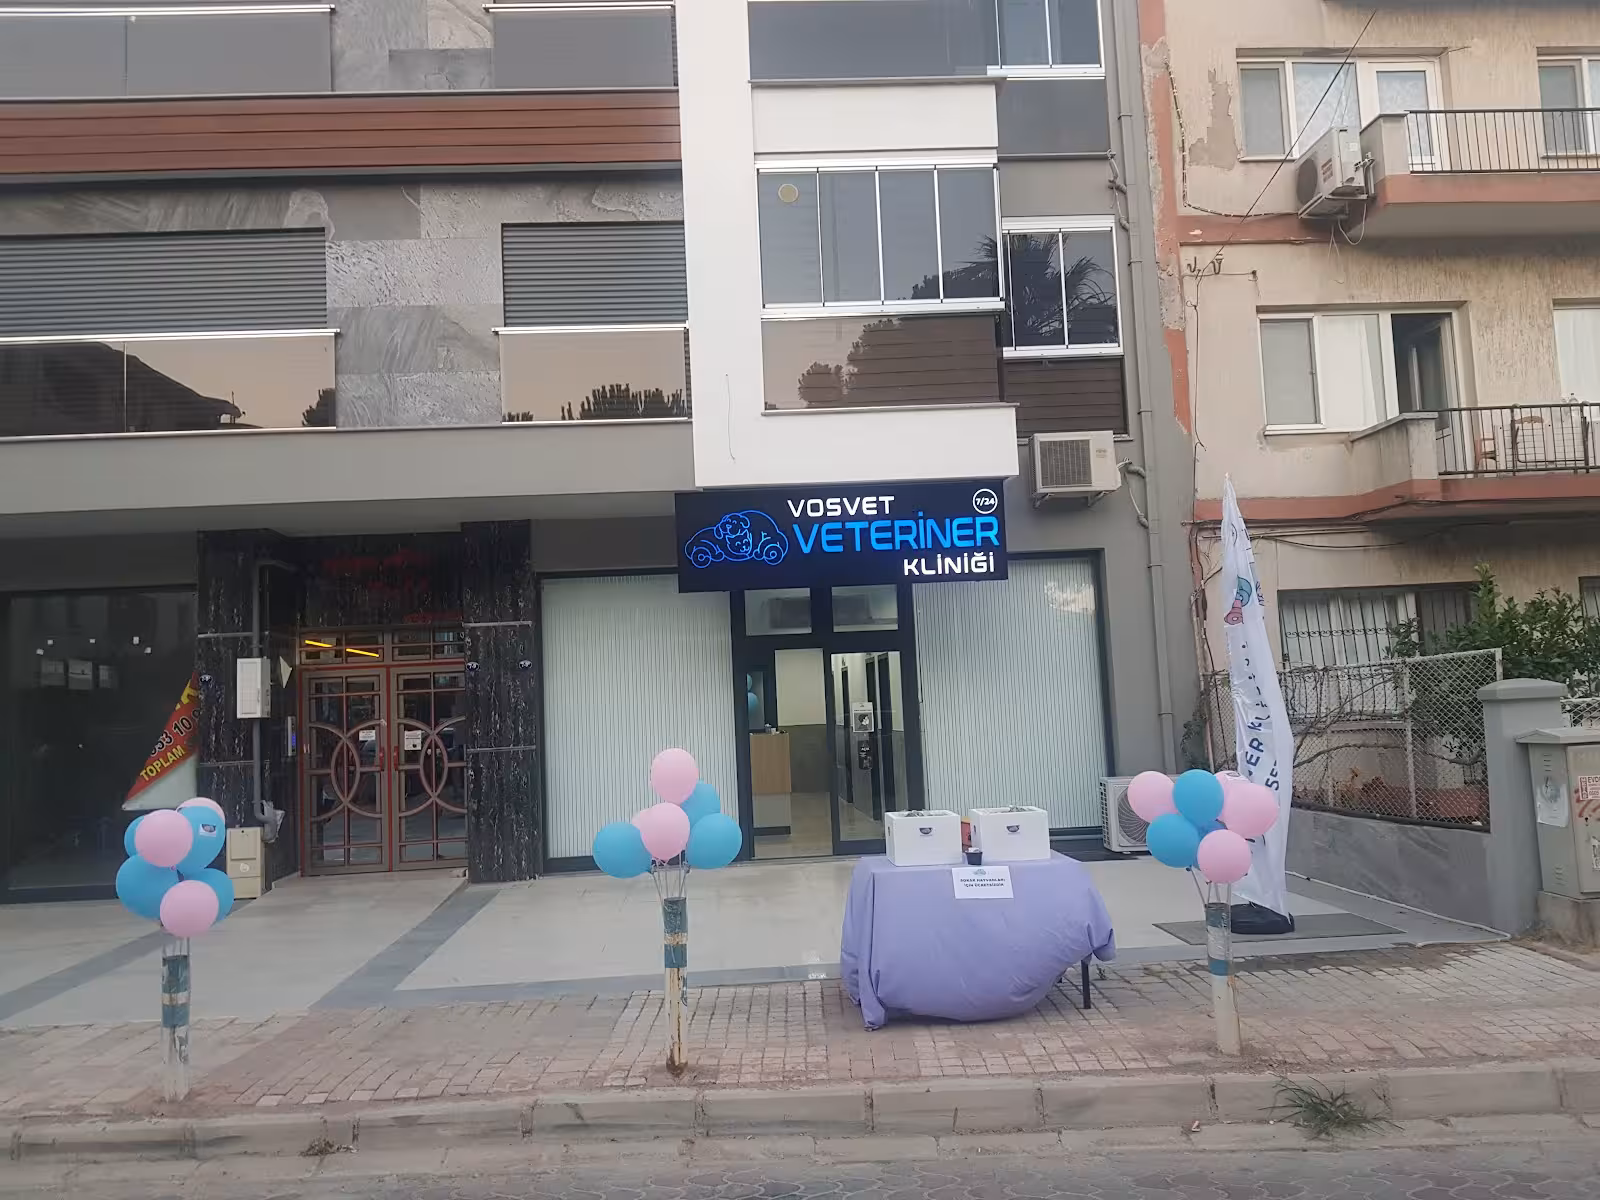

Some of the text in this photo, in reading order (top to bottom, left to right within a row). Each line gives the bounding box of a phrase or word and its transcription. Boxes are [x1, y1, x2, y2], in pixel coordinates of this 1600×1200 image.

[787, 496, 895, 517] VOSVET
[976, 497, 995, 506] 7/24
[792, 511, 1000, 554] VETERİNER
[904, 552, 995, 576] KLİNİĞİ
[172, 716, 193, 736] 10
[140, 745, 186, 781] TOPLAM
